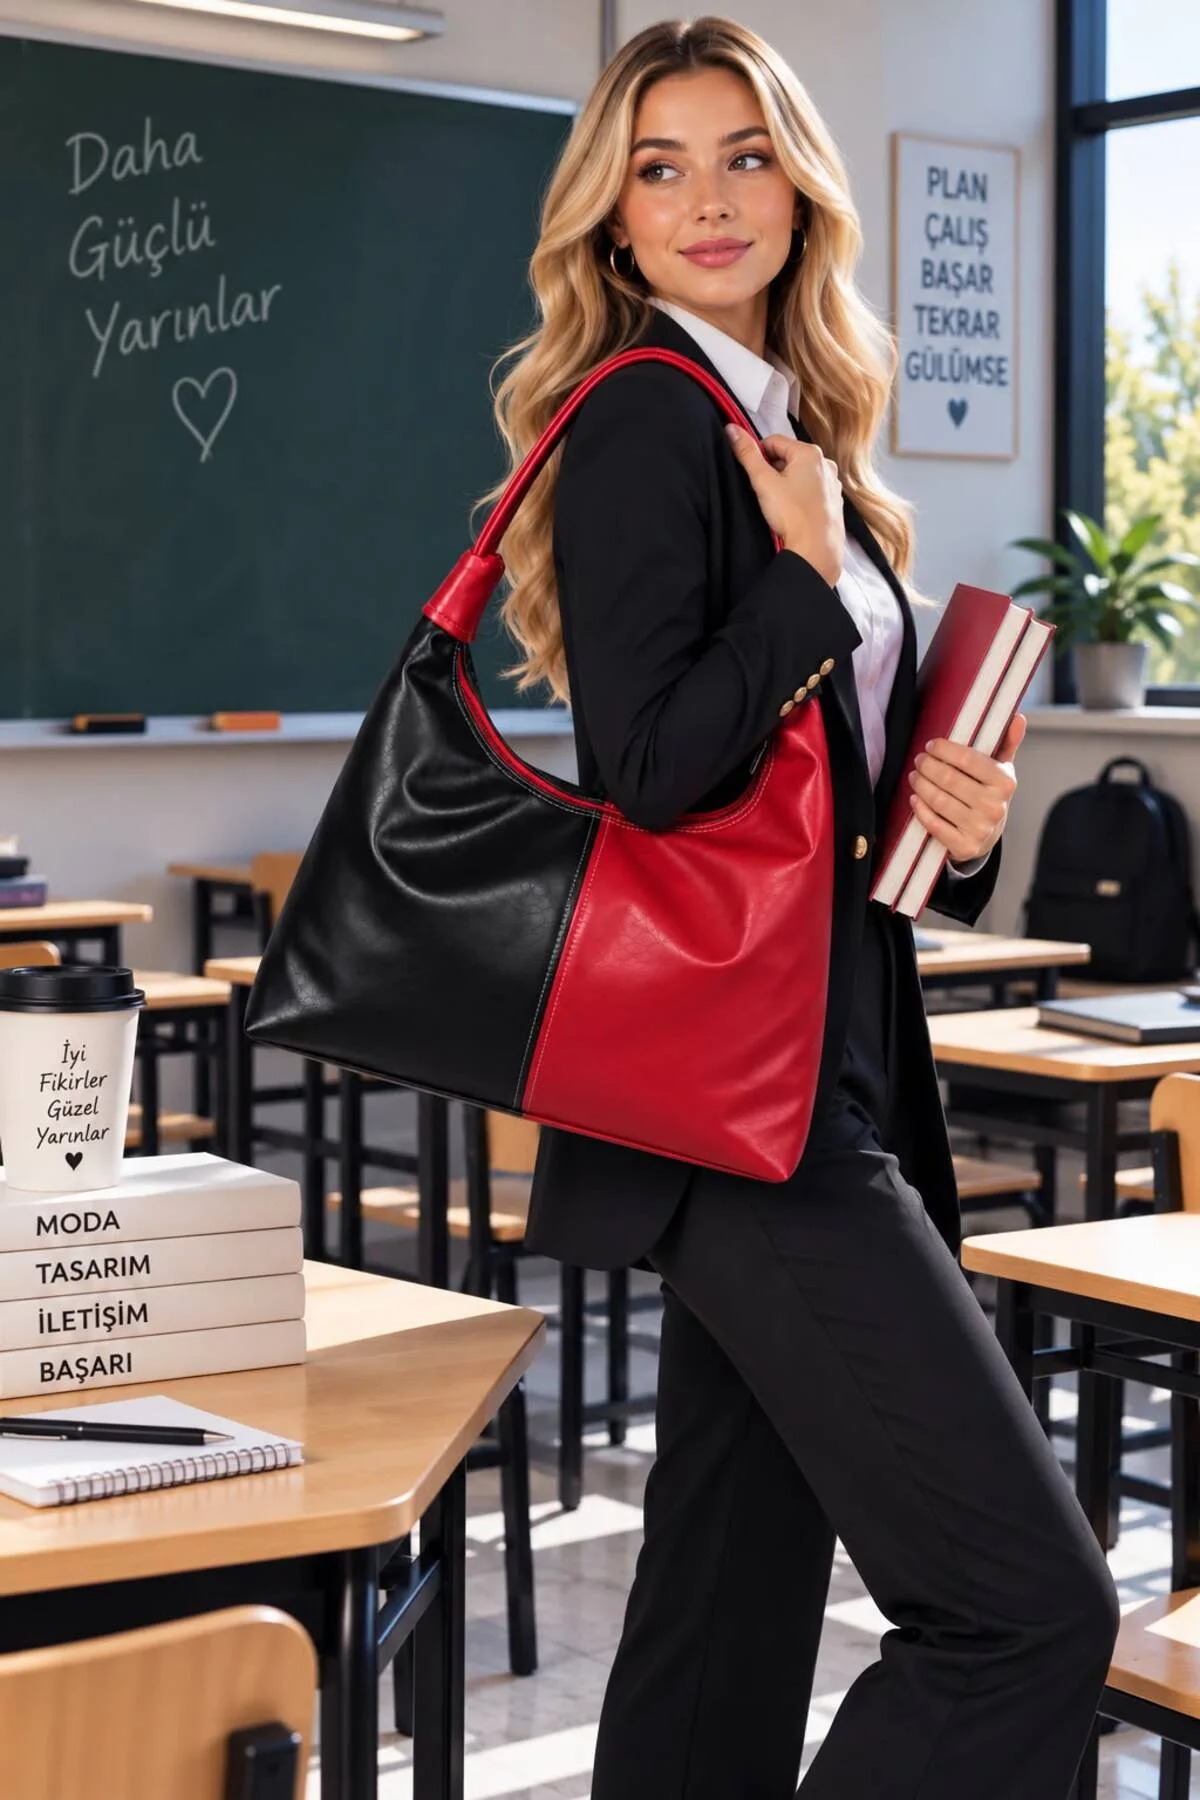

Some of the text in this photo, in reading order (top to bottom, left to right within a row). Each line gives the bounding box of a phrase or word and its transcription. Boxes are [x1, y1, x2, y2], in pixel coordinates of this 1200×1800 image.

[65, 116, 204, 195] Daha
[927, 165, 988, 203] PLAN
[69, 196, 216, 281] Güçlü
[925, 212, 989, 255] ÇALIŞ
[921, 258, 994, 299] BAŞAR
[86, 273, 282, 378] Yarınlar
[913, 303, 1000, 340] TEKRAR
[905, 345, 1009, 387] GÜLÜMSE
[61, 1039, 87, 1070] İyi
[40, 1070, 108, 1092] Fikirler
[47, 1096, 99, 1121] Güzel
[37, 1123, 110, 1150] Yarınlar
[36, 1210, 120, 1236] MODA
[35, 1254, 151, 1284] TASARIM
[38, 1300, 148, 1334] İLETİŞİM
[40, 1352, 132, 1384] BAŞARI
